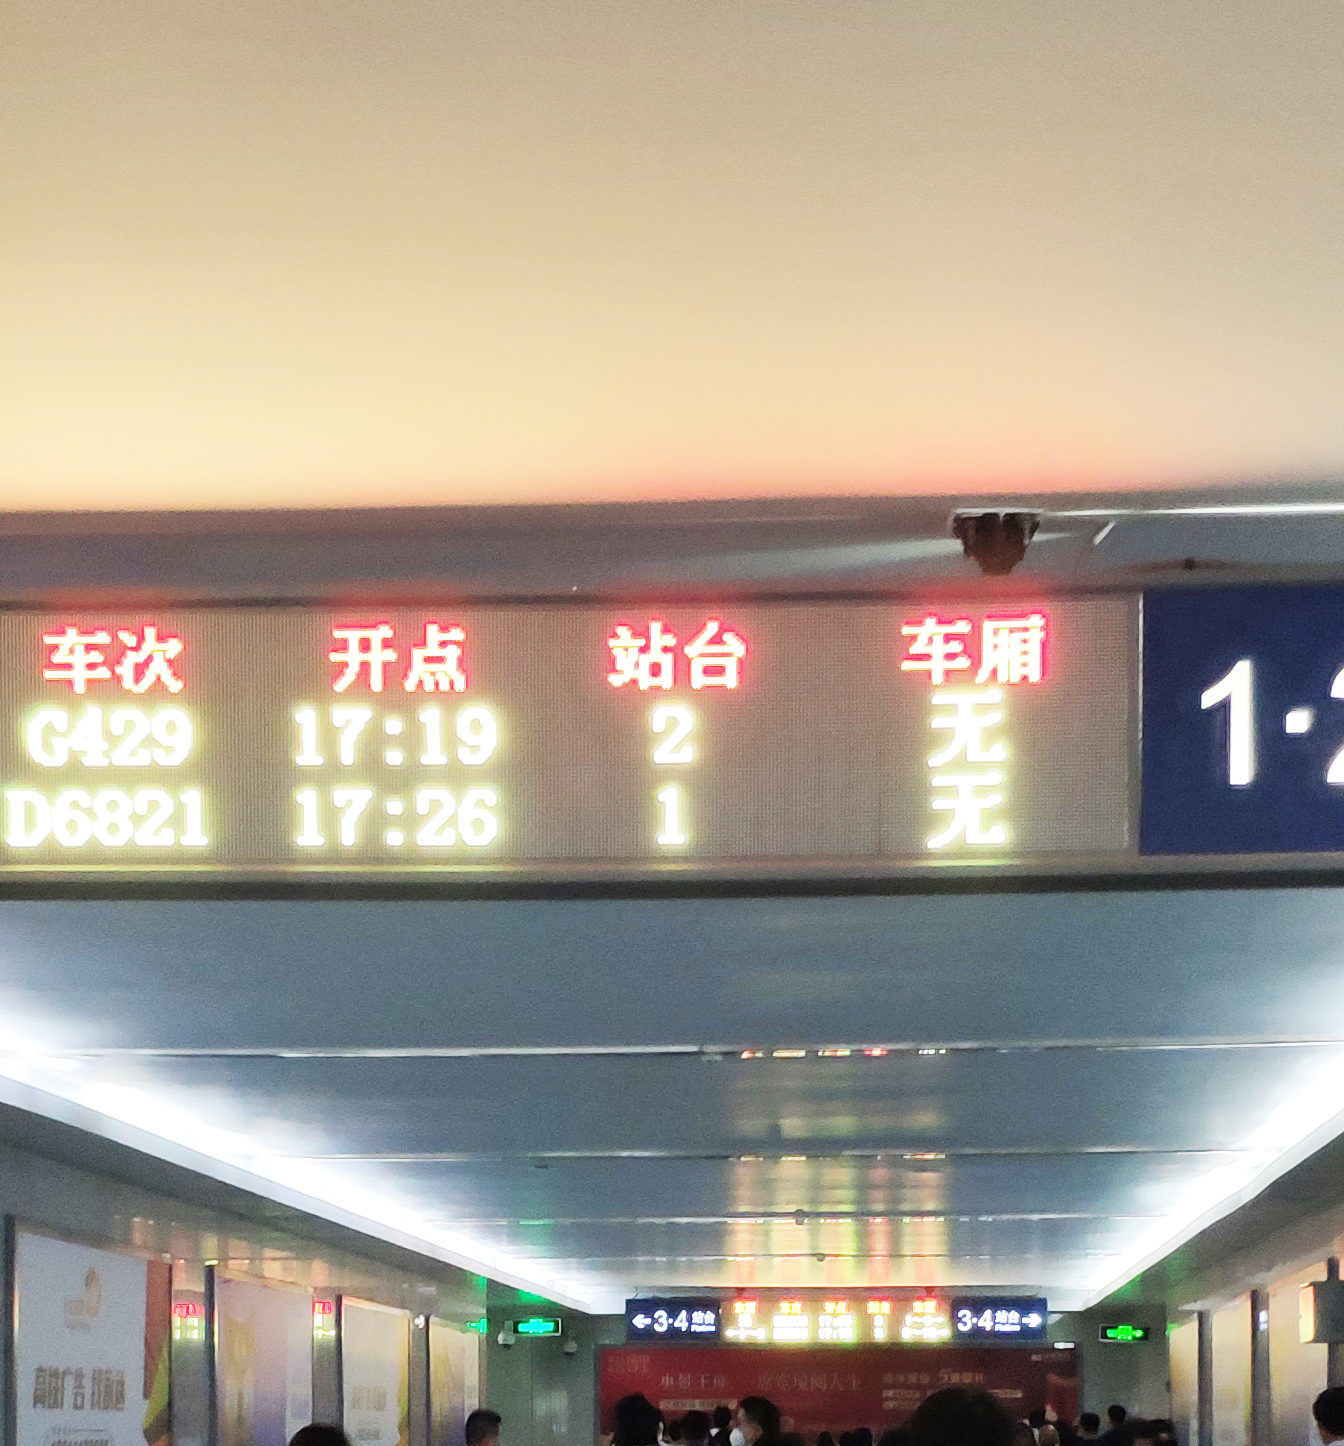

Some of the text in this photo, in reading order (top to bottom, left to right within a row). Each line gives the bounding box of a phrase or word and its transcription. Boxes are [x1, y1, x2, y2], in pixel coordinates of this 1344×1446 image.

[43, 626, 183, 694] 车次
[330, 624, 467, 692] 开点
[608, 621, 747, 690] 站台
[901, 613, 1046, 686] 车厢
[23, 705, 194, 767] G429
[294, 705, 498, 766] 17:19
[651, 706, 693, 764] 2
[927, 689, 1007, 767] 无
[3, 787, 210, 849] D6821
[294, 787, 498, 848] 17:26
[657, 787, 686, 845] 1
[927, 771, 1007, 848] 无
